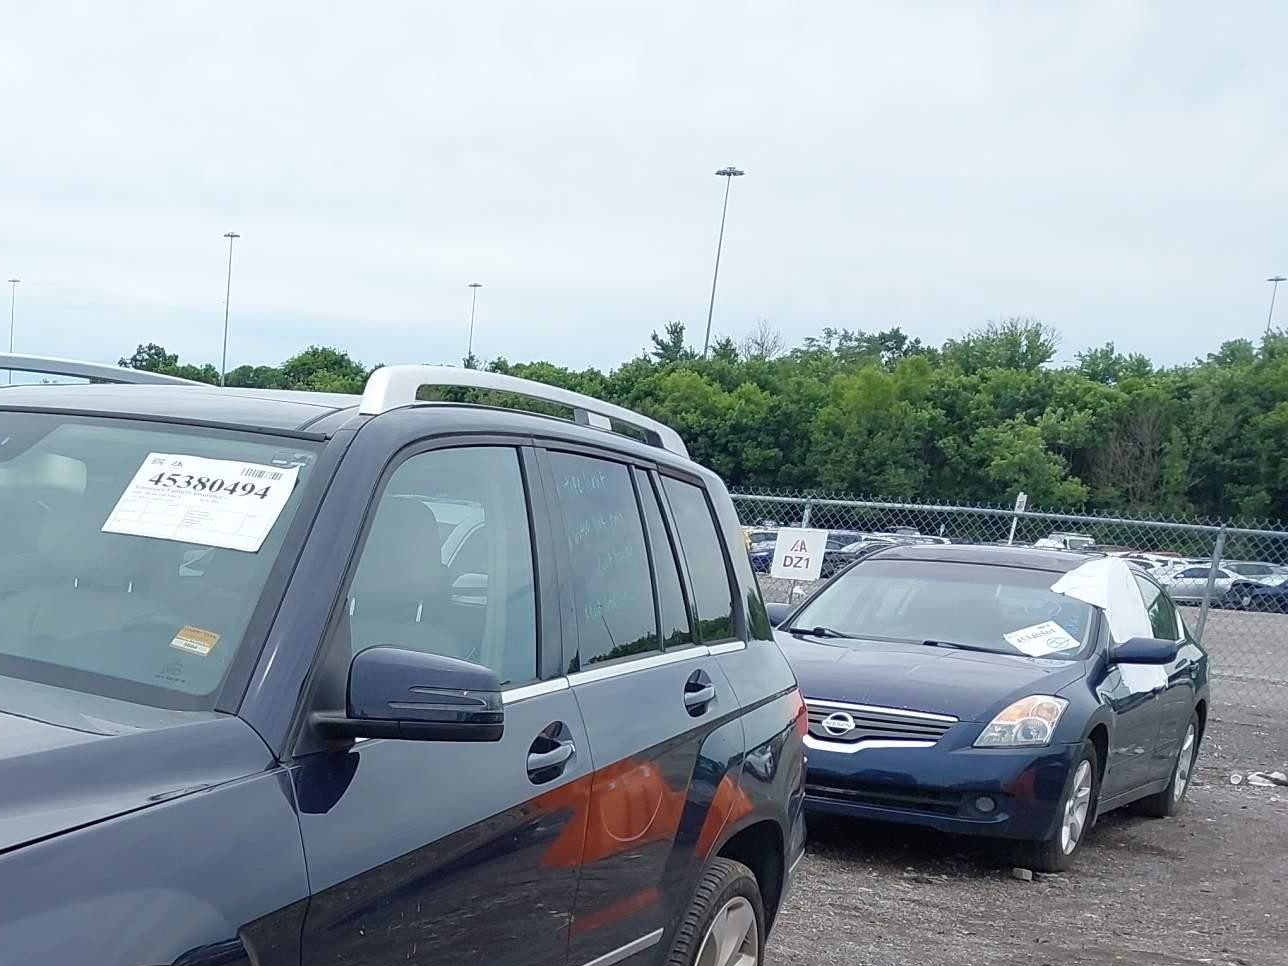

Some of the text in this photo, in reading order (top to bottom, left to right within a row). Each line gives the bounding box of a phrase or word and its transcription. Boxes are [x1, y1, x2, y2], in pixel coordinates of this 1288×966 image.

[147, 471, 272, 500] 45380494
[782, 555, 811, 569] DZ1
[824, 719, 852, 729] NISSAN
